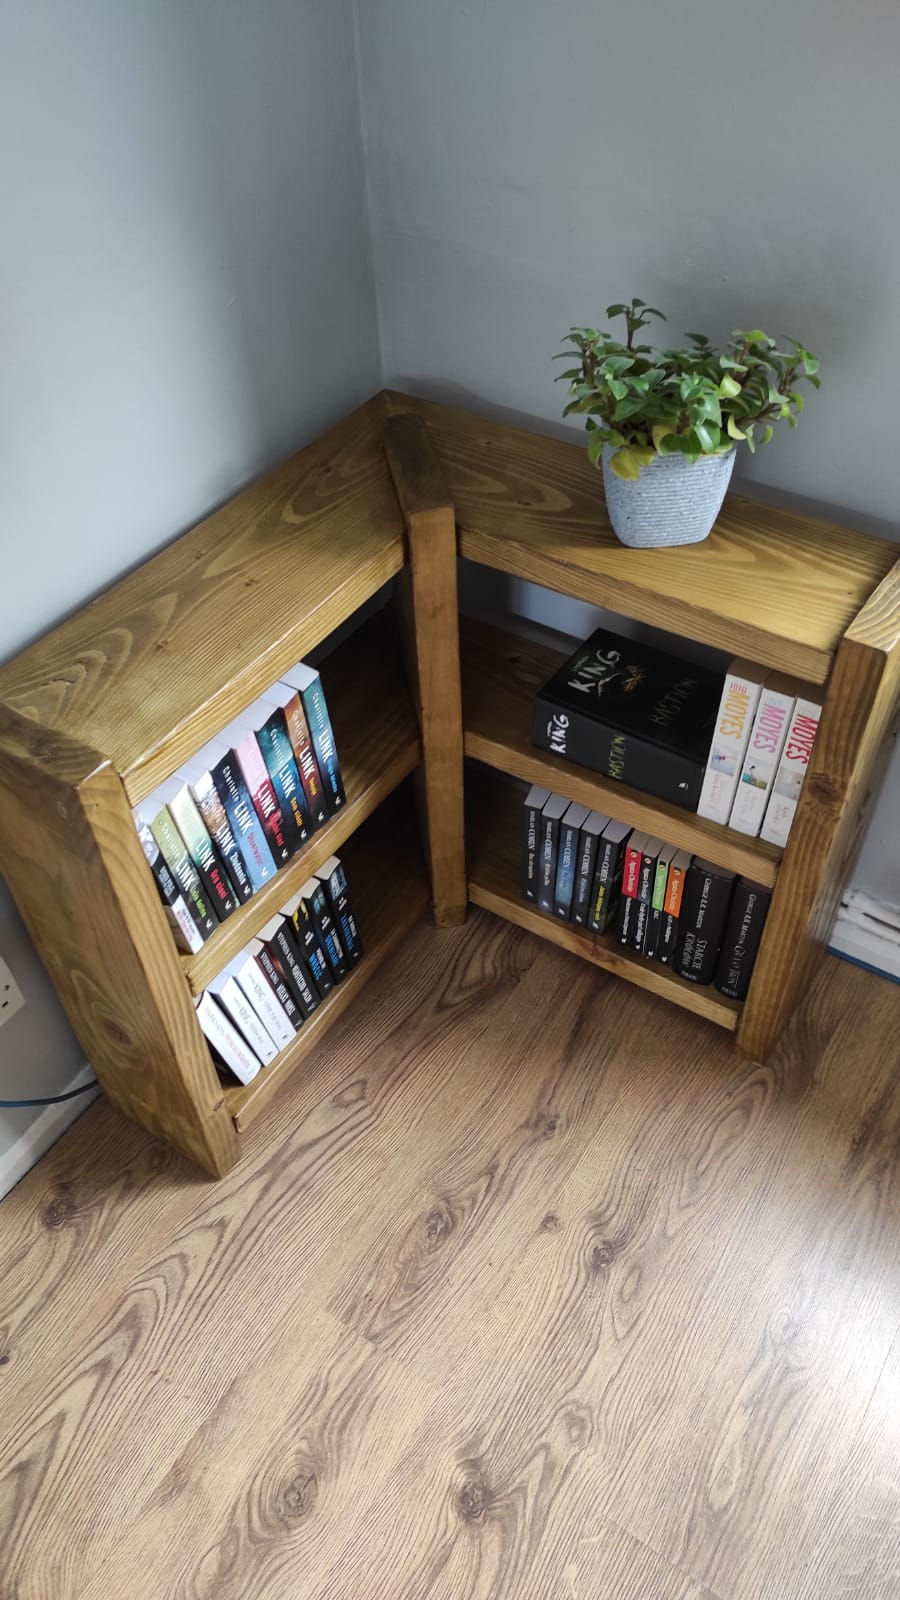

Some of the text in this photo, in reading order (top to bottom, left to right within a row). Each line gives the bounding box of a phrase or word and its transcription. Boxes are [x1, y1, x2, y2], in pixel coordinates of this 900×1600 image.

[567, 649, 621, 693] KING
[648, 677, 697, 726] BASTION
[717, 690, 751, 741] MOYES
[550, 713, 570, 753] KING
[753, 703, 786, 753] MOYES
[786, 713, 819, 764] MOYES
[299, 746, 318, 780] LINK
[319, 729, 335, 764] LINK
[608, 735, 626, 779] BASTION
[280, 765, 297, 799] LINK
[223, 766, 241, 803] Charlotte
[234, 801, 255, 835] LINK
[258, 785, 277, 819] LINK
[218, 823, 237, 856] LINK
[544, 839, 552, 861] COBEN
[175, 855, 196, 892] LINK
[195, 837, 215, 872] LINK
[211, 869, 222, 884] Gra
[562, 848, 572, 869] COBEN
[580, 855, 591, 875] COBEN
[599, 862, 610, 883] COBEN
[701, 877, 712, 899] GEORGE
[744, 893, 757, 914] GEORGE
[695, 909, 705, 928] MARTIN
[738, 924, 748, 945] MARTIN
[259, 951, 275, 975] STEPHEN
[270, 970, 280, 985] KING
[277, 931, 292, 956] STEPHEN
[285, 952, 297, 968] KING
[301, 987, 314, 1005] SALEM
[691, 938, 708, 970] STARCIE
